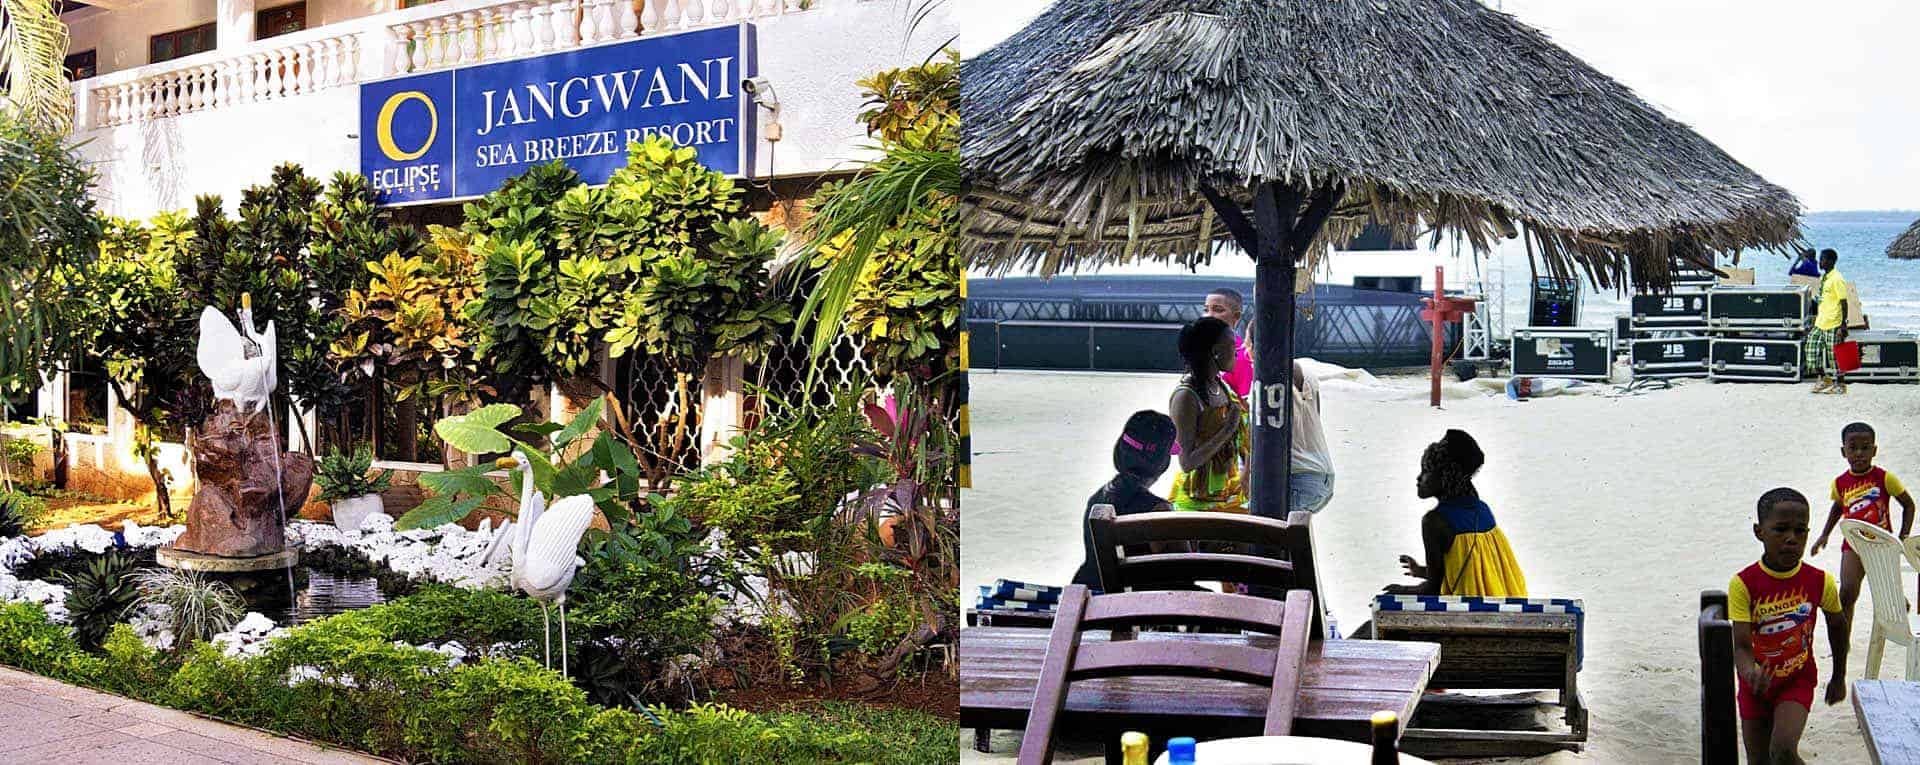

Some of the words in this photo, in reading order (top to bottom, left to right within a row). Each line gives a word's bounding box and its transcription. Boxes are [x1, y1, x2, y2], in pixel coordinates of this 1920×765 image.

[476, 56, 734, 136] JANGWANI
[476, 143, 518, 168] SEA
[523, 130, 619, 163] BREEZE
[373, 163, 441, 190] ECLIPSE
[1254, 380, 1286, 429] 19
